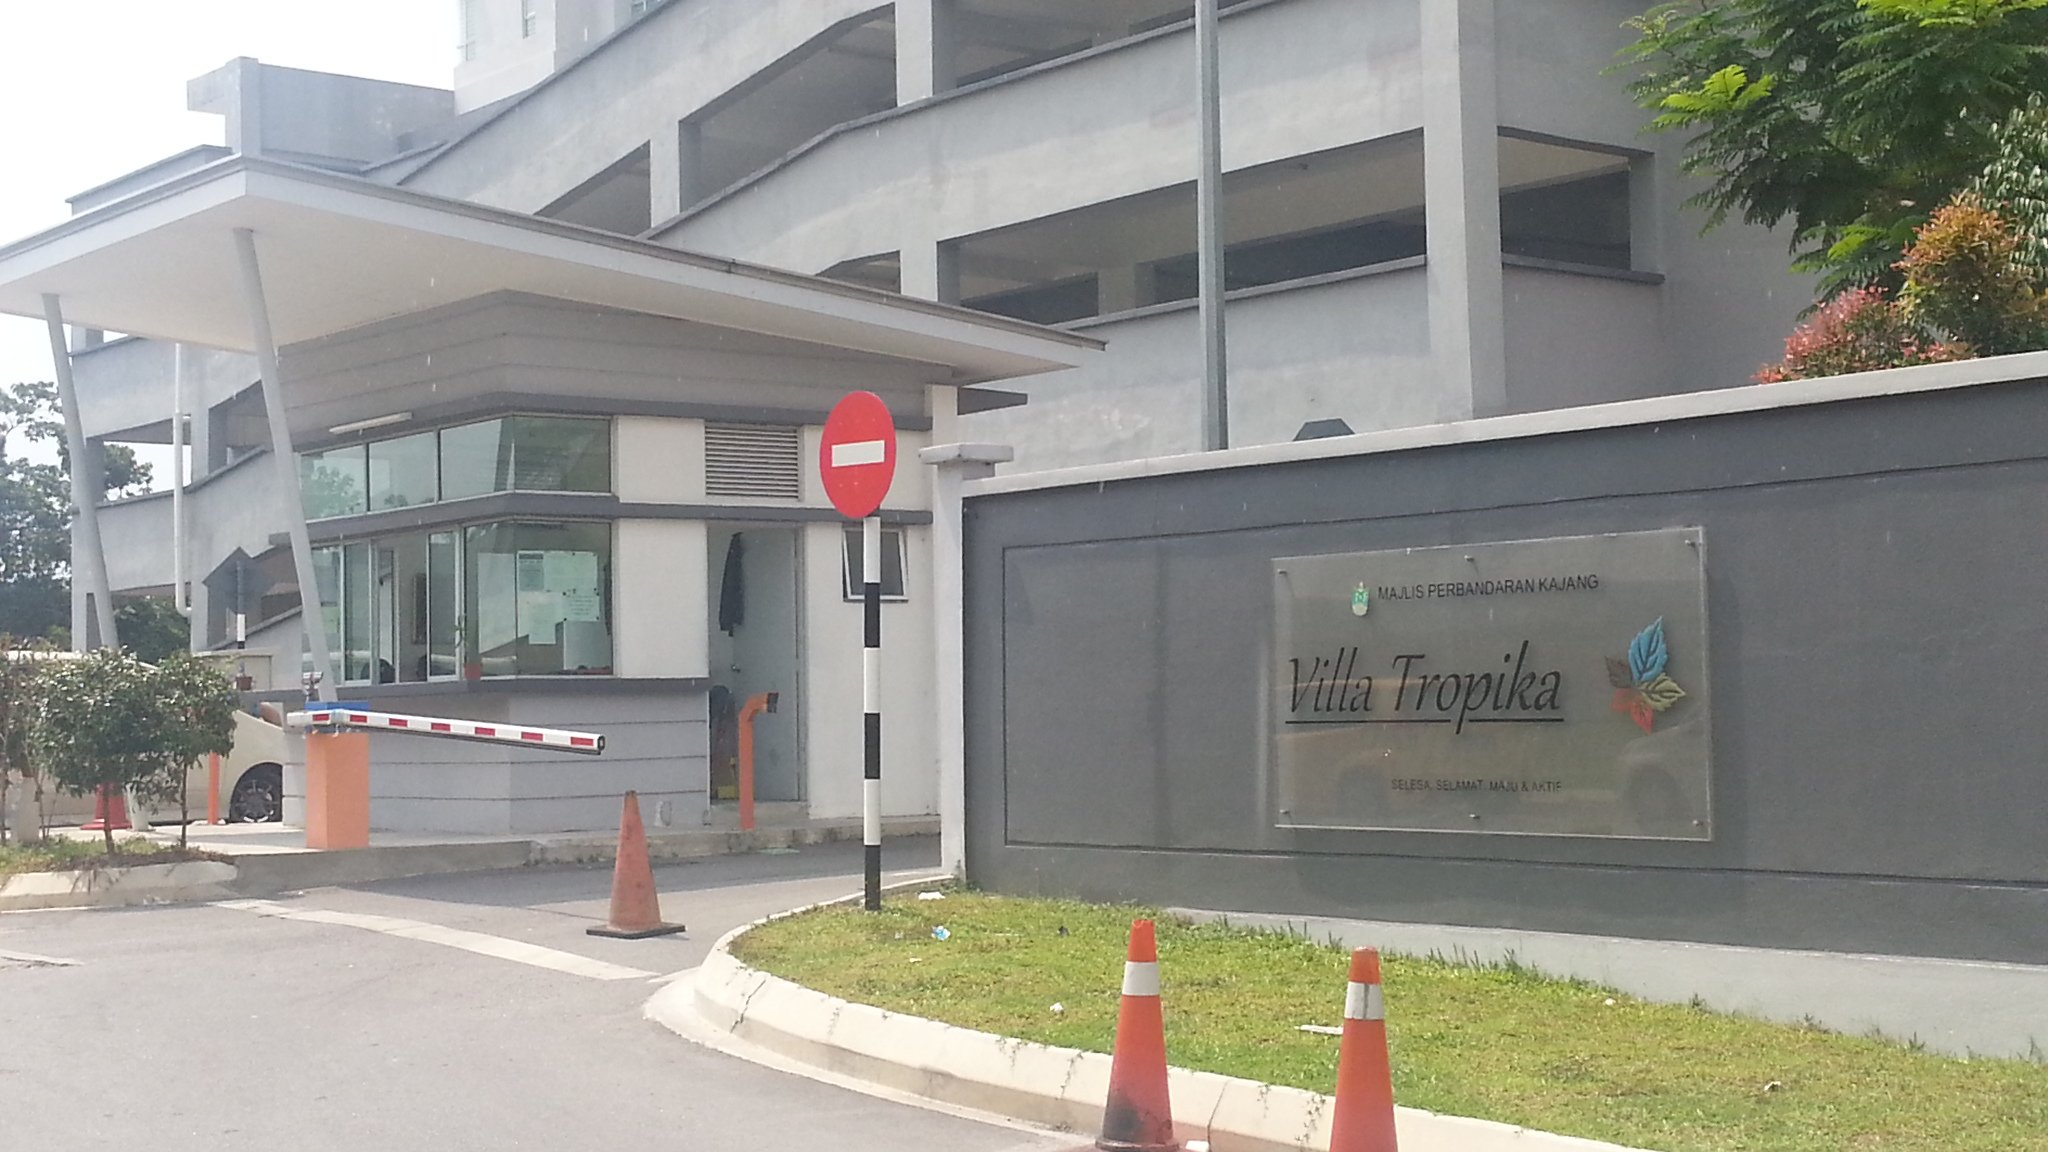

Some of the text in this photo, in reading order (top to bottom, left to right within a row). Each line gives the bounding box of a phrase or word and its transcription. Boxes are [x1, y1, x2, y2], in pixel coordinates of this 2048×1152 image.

[1378, 574, 1599, 600] MAJLIS PERBANDARAN KAJANG
[1289, 640, 1561, 735] Villa Tropika
[1521, 781, 1529, 792] &
